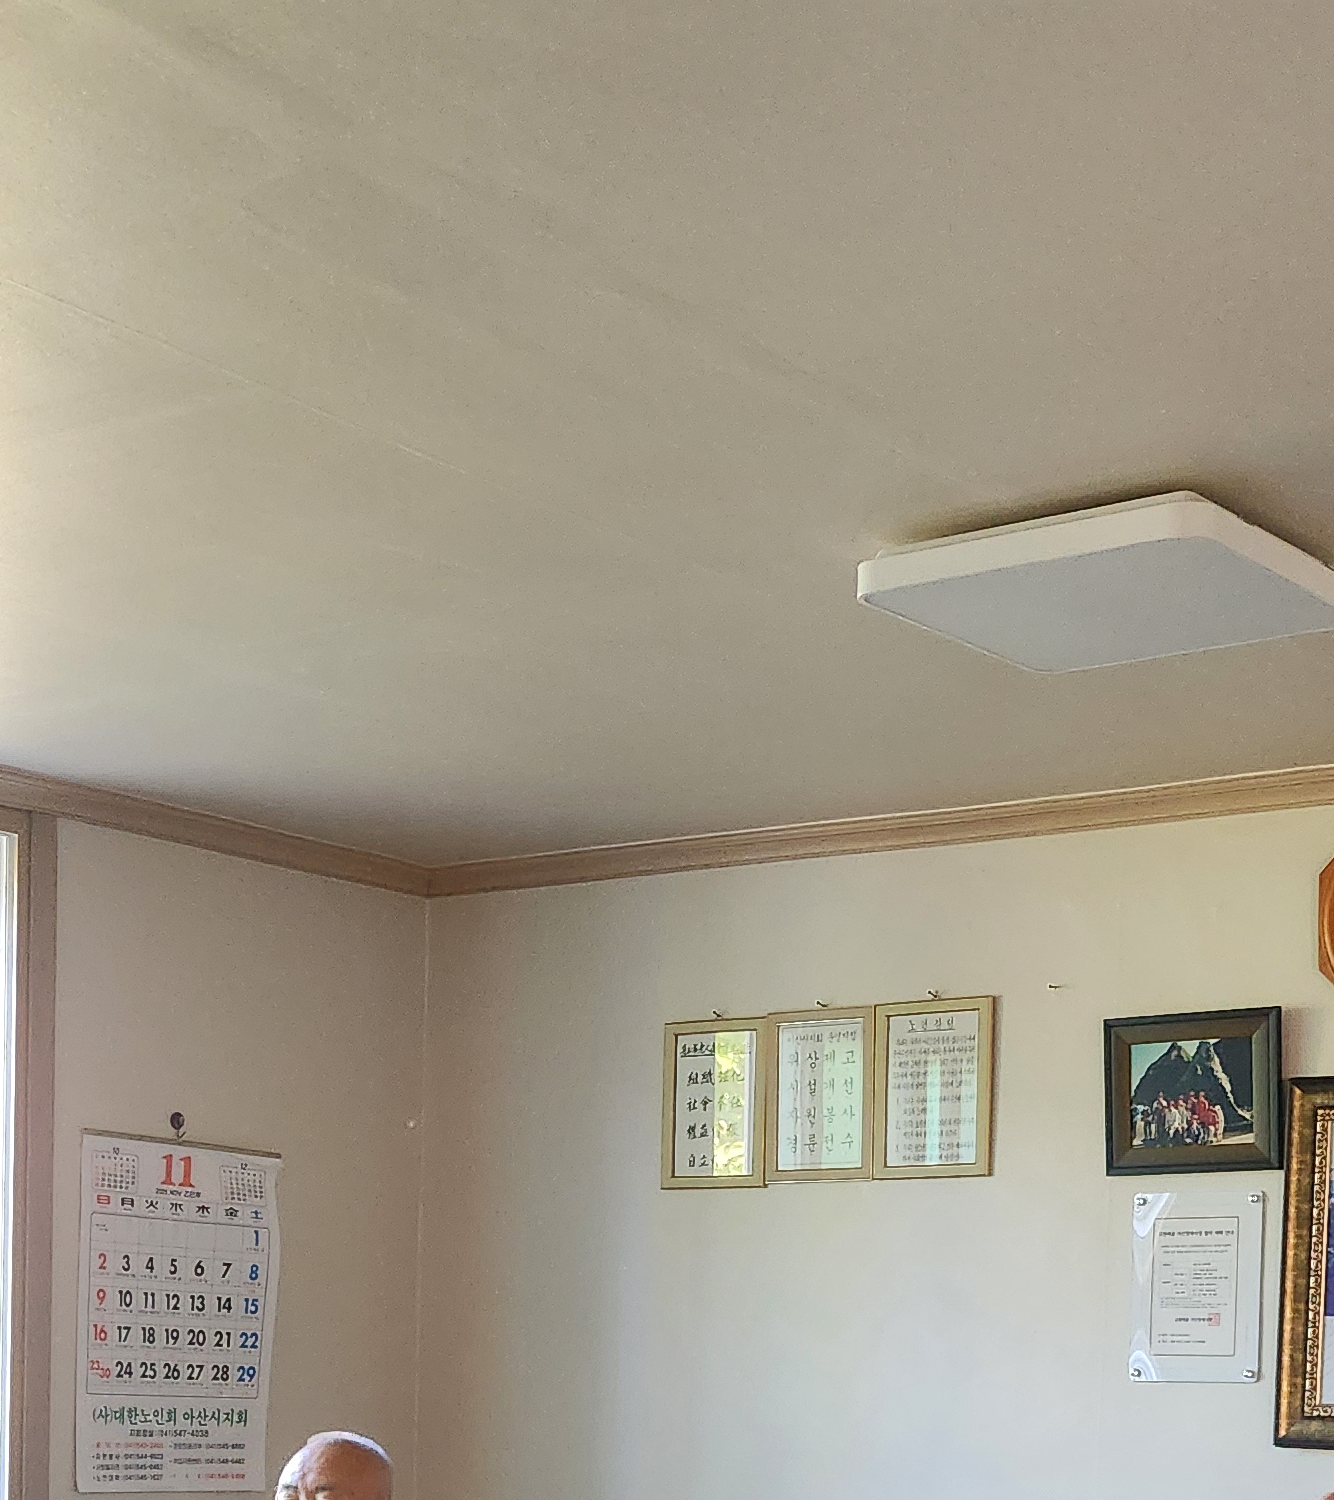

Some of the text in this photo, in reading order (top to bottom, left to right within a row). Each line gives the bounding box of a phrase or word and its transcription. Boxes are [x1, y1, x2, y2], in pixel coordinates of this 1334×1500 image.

[160, 1153, 195, 1188] 11
[97, 1195, 263, 1220] 日 月 火 水 木 金 土
[254, 1230, 259, 1246] 1
[98, 1253, 259, 1281] 2 3 4 5 6 7 8
[96, 1289, 259, 1314] 9 10 11 12 13 14 15
[93, 1324, 259, 1349] 16 17 18 19 20 21 22
[90, 1360, 256, 1383] 23 30 24 25 26 27 28 29
[92, 1405, 248, 1427] (사)대한노인회 아산시지회
